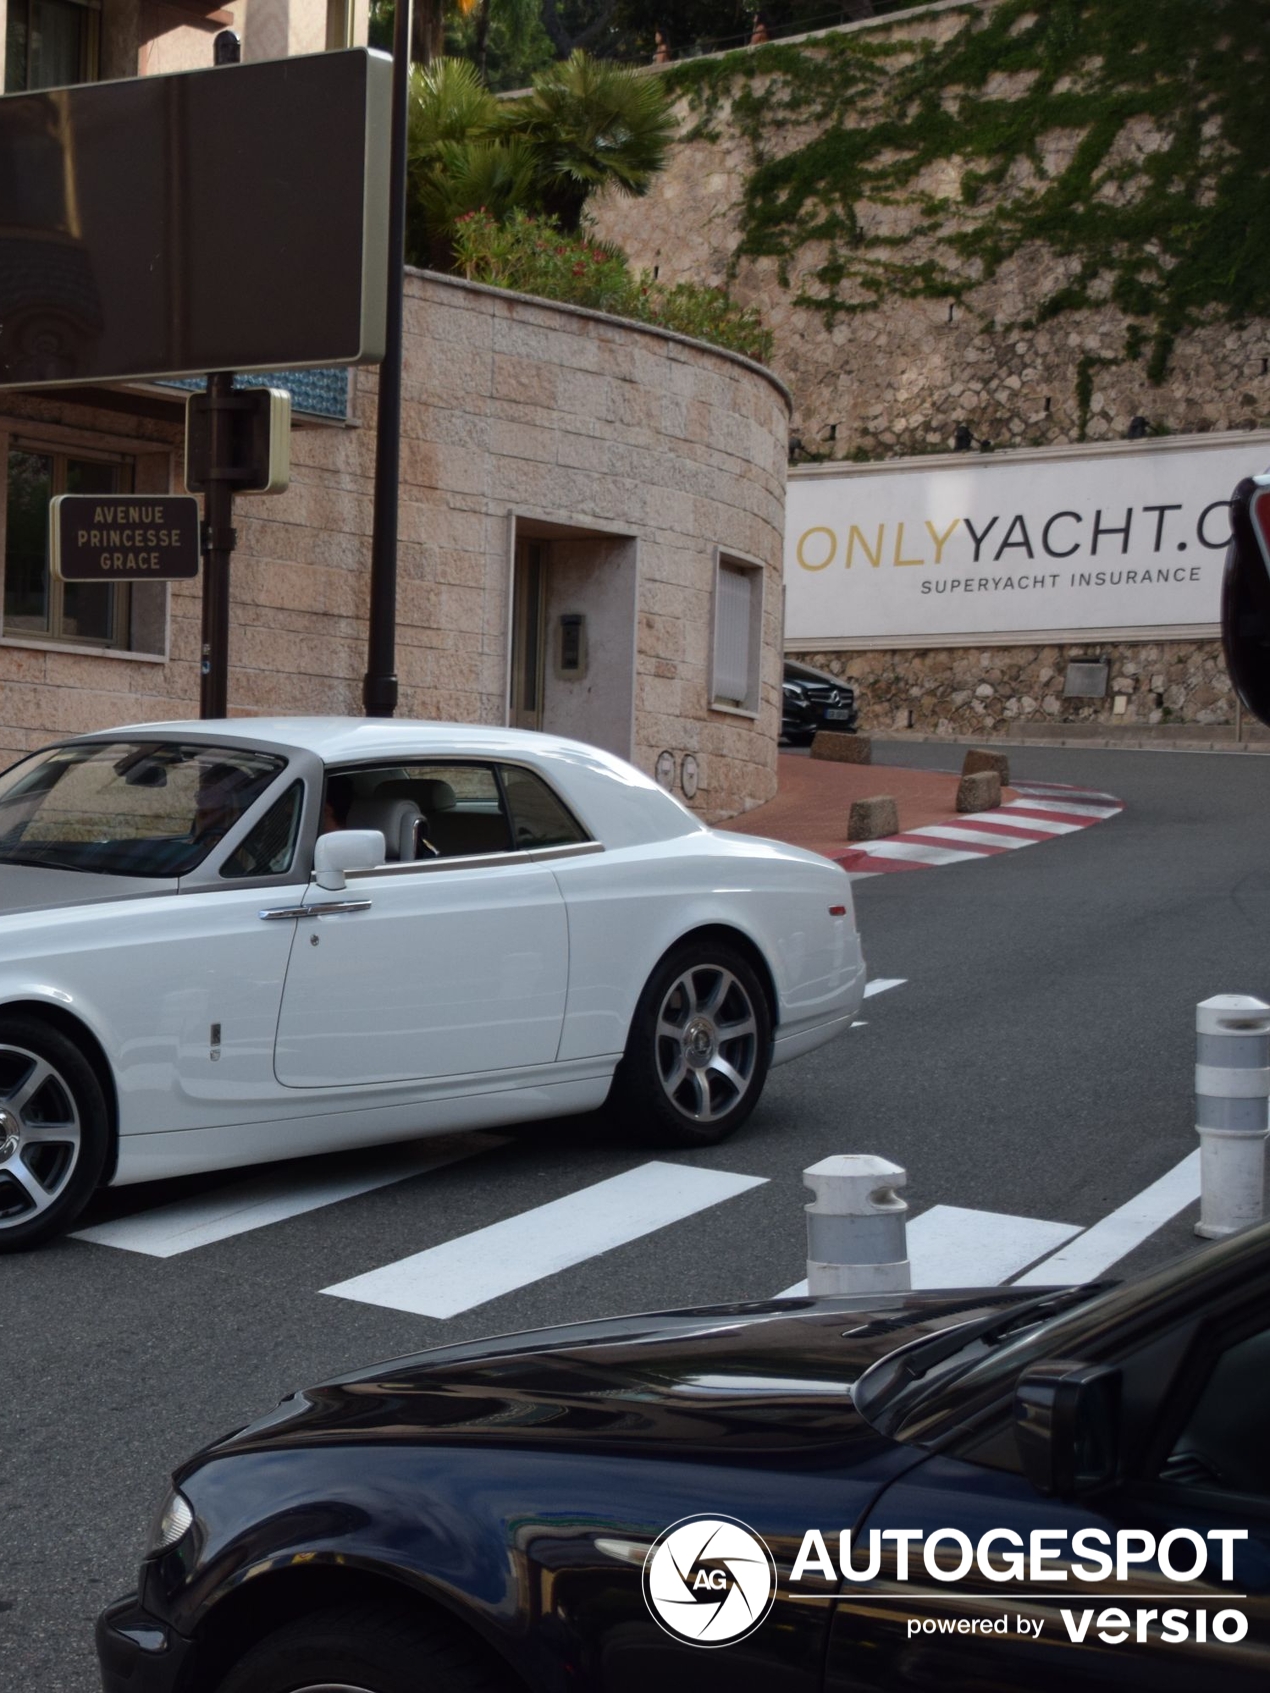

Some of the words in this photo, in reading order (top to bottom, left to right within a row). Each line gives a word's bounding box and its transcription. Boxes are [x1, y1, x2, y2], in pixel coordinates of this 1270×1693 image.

[94, 506, 164, 524] AVENUE
[78, 530, 181, 547] PRINCESSE
[100, 553, 160, 570] GRACE
[920, 573, 1060, 595] SUPERYACHT
[1070, 566, 1202, 588] INSURANCE
